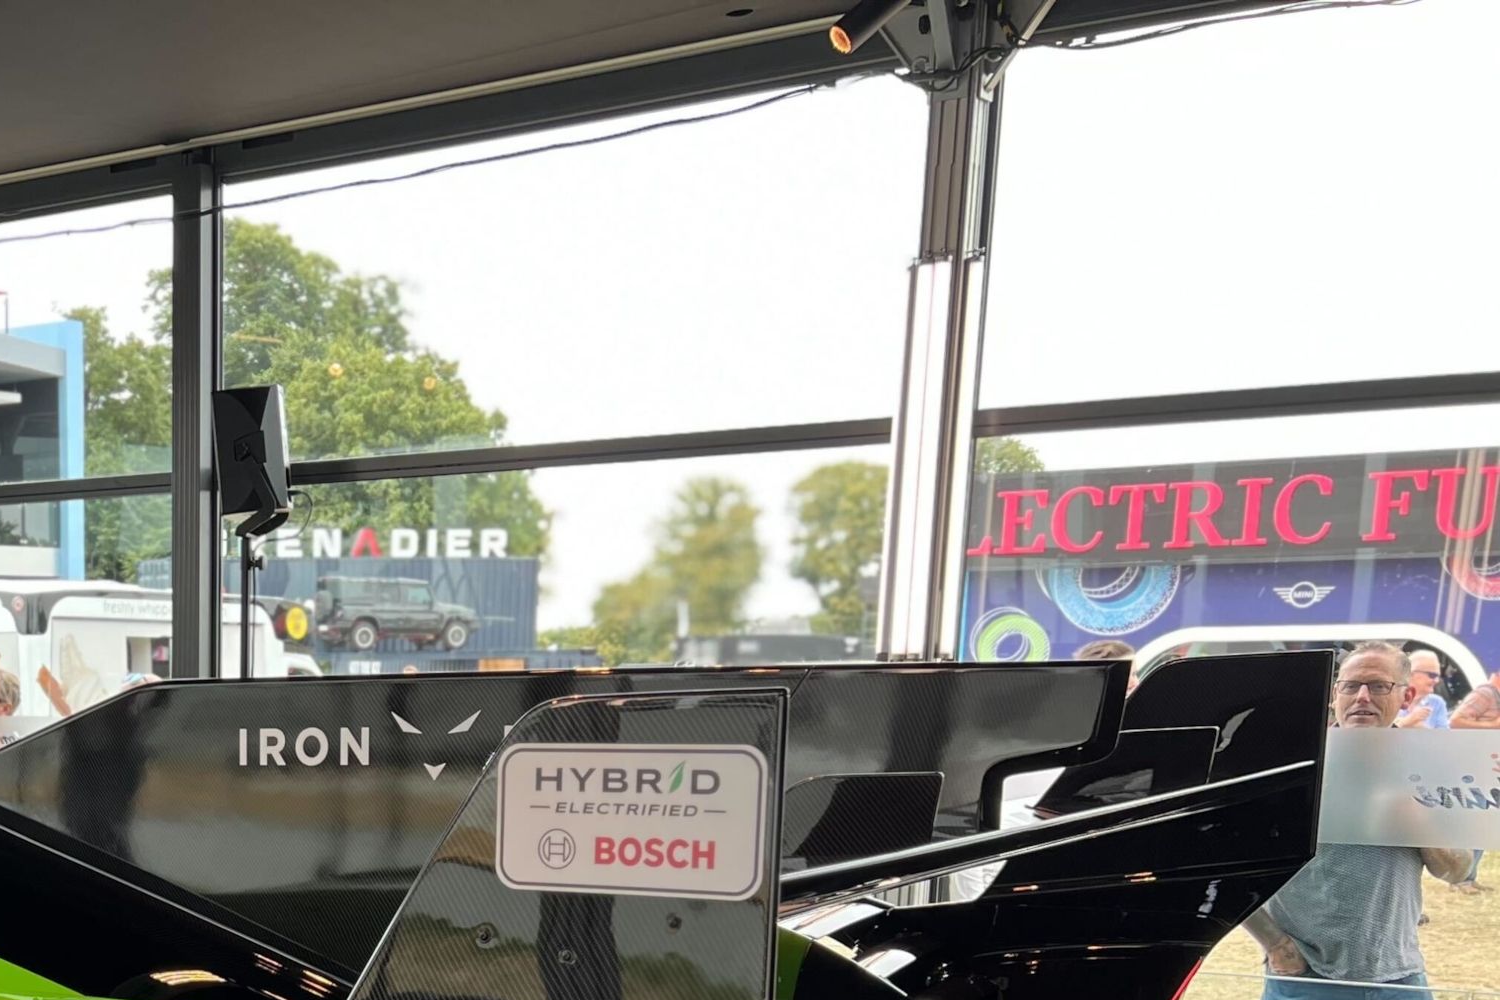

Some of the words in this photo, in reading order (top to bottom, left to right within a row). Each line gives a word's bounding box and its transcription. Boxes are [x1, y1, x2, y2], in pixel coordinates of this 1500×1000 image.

[967, 474, 1333, 556] ECTRIC
[220, 528, 509, 558] ENADIER
[102, 599, 134, 617] freshly
[137, 602, 171, 618] whipp
[1293, 590, 1314, 599] MINI
[239, 727, 370, 766] IRON
[534, 761, 721, 795] HYBRID
[555, 802, 698, 817] ELECTRIFIED
[594, 836, 716, 870] BOSCH
